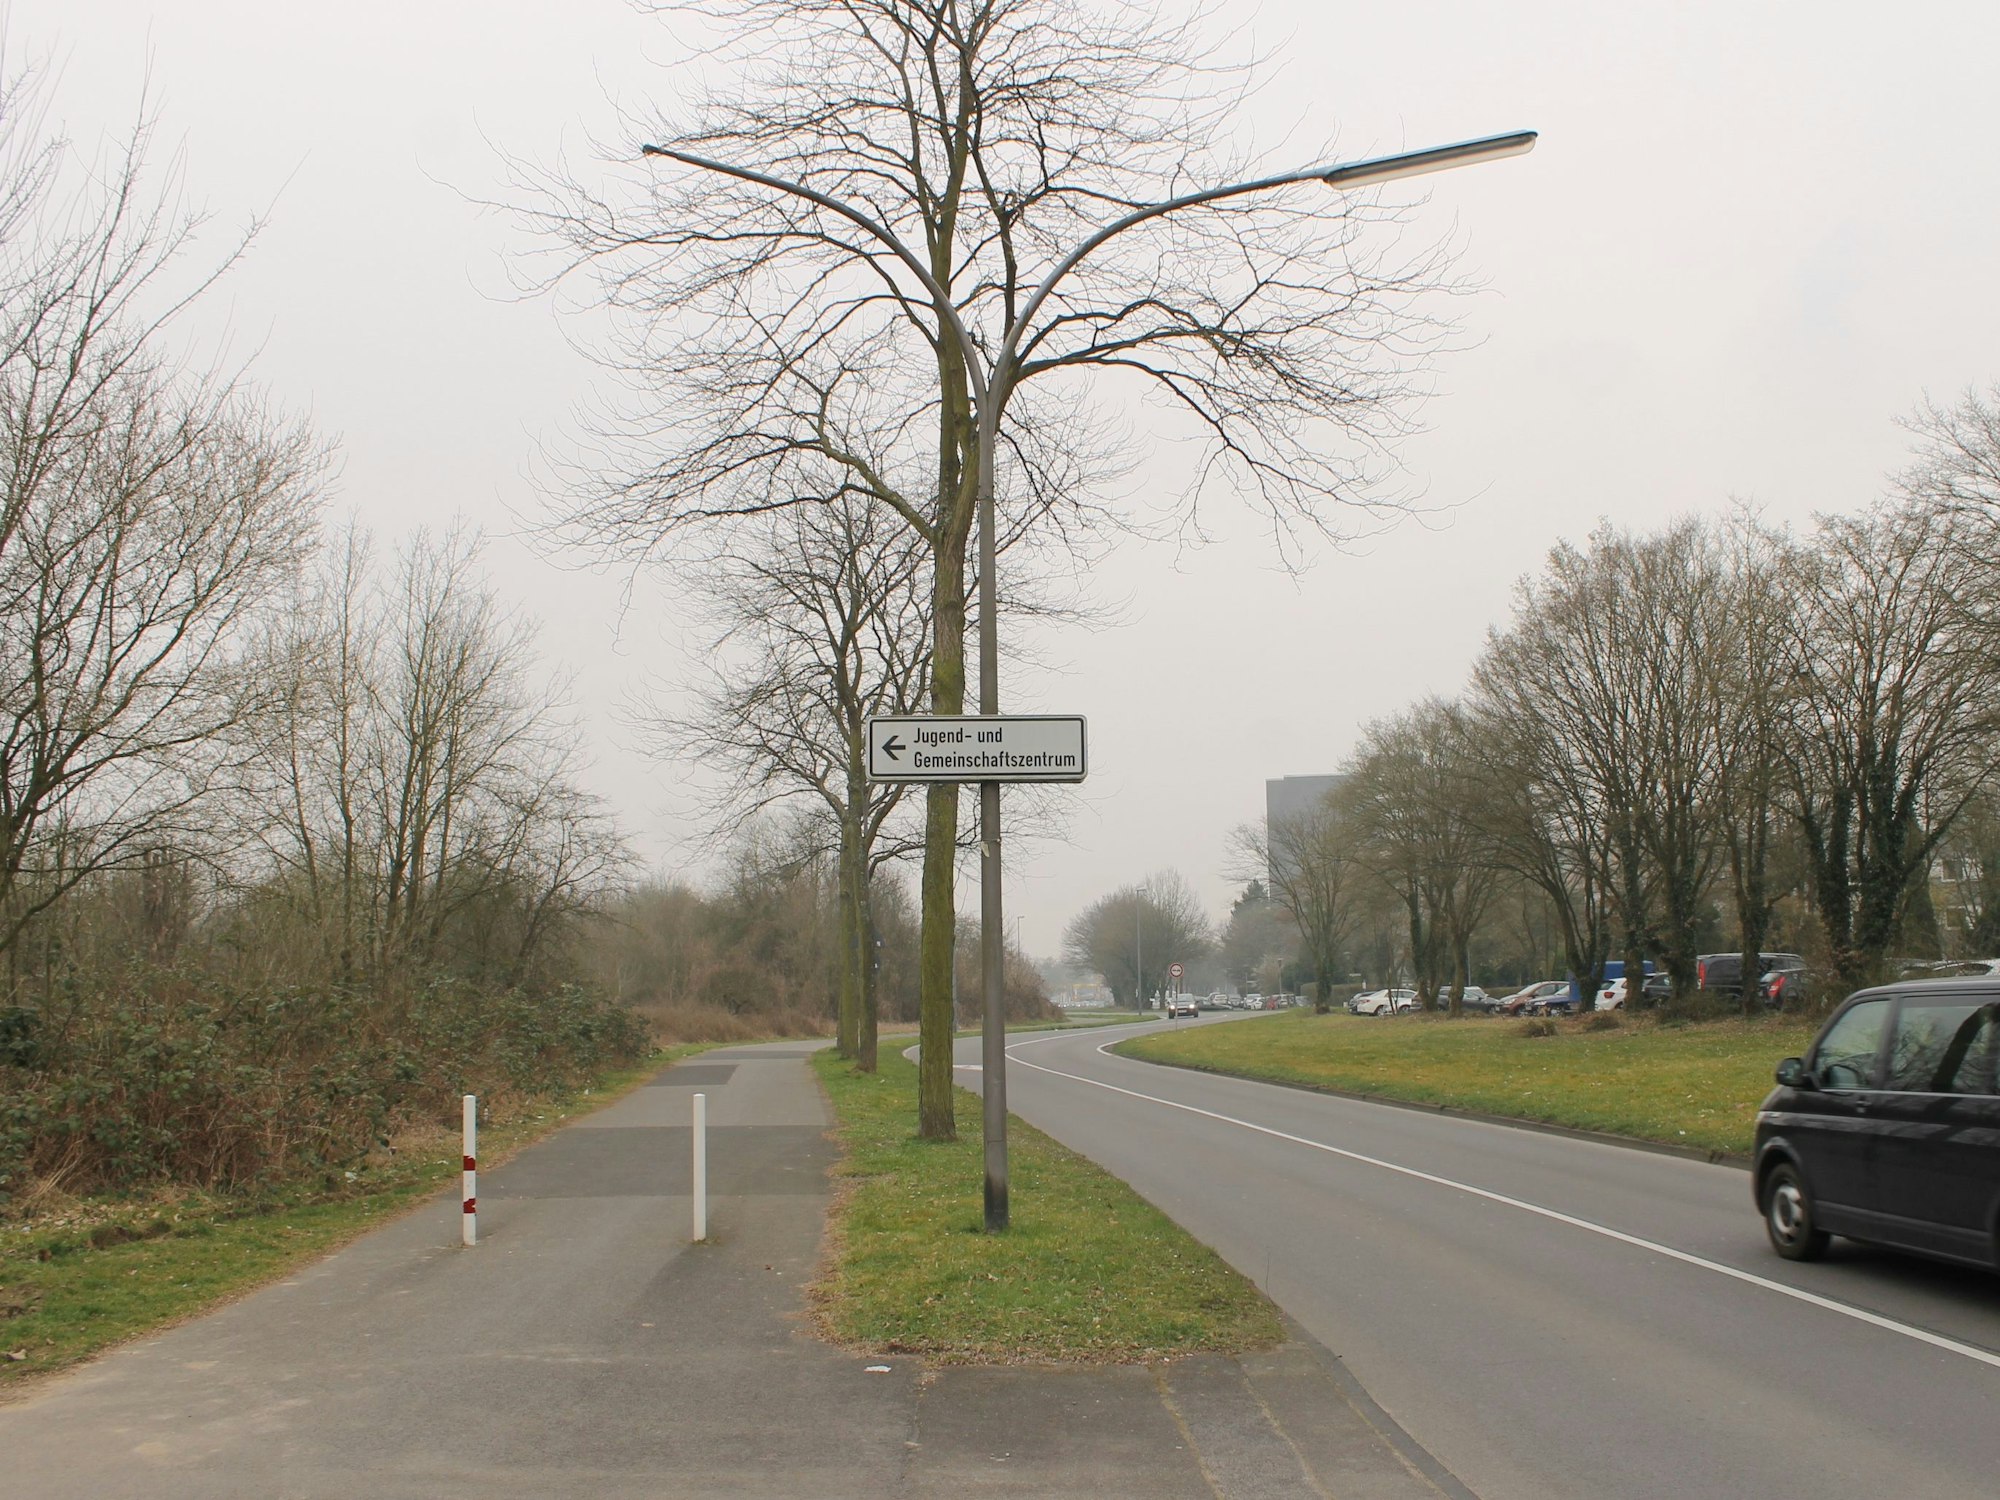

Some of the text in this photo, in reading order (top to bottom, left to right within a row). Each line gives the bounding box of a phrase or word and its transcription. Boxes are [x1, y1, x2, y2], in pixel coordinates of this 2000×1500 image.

[914, 727, 1003, 747] Jugend- und
[914, 751, 1076, 768] Gemeinschaftszentrum
